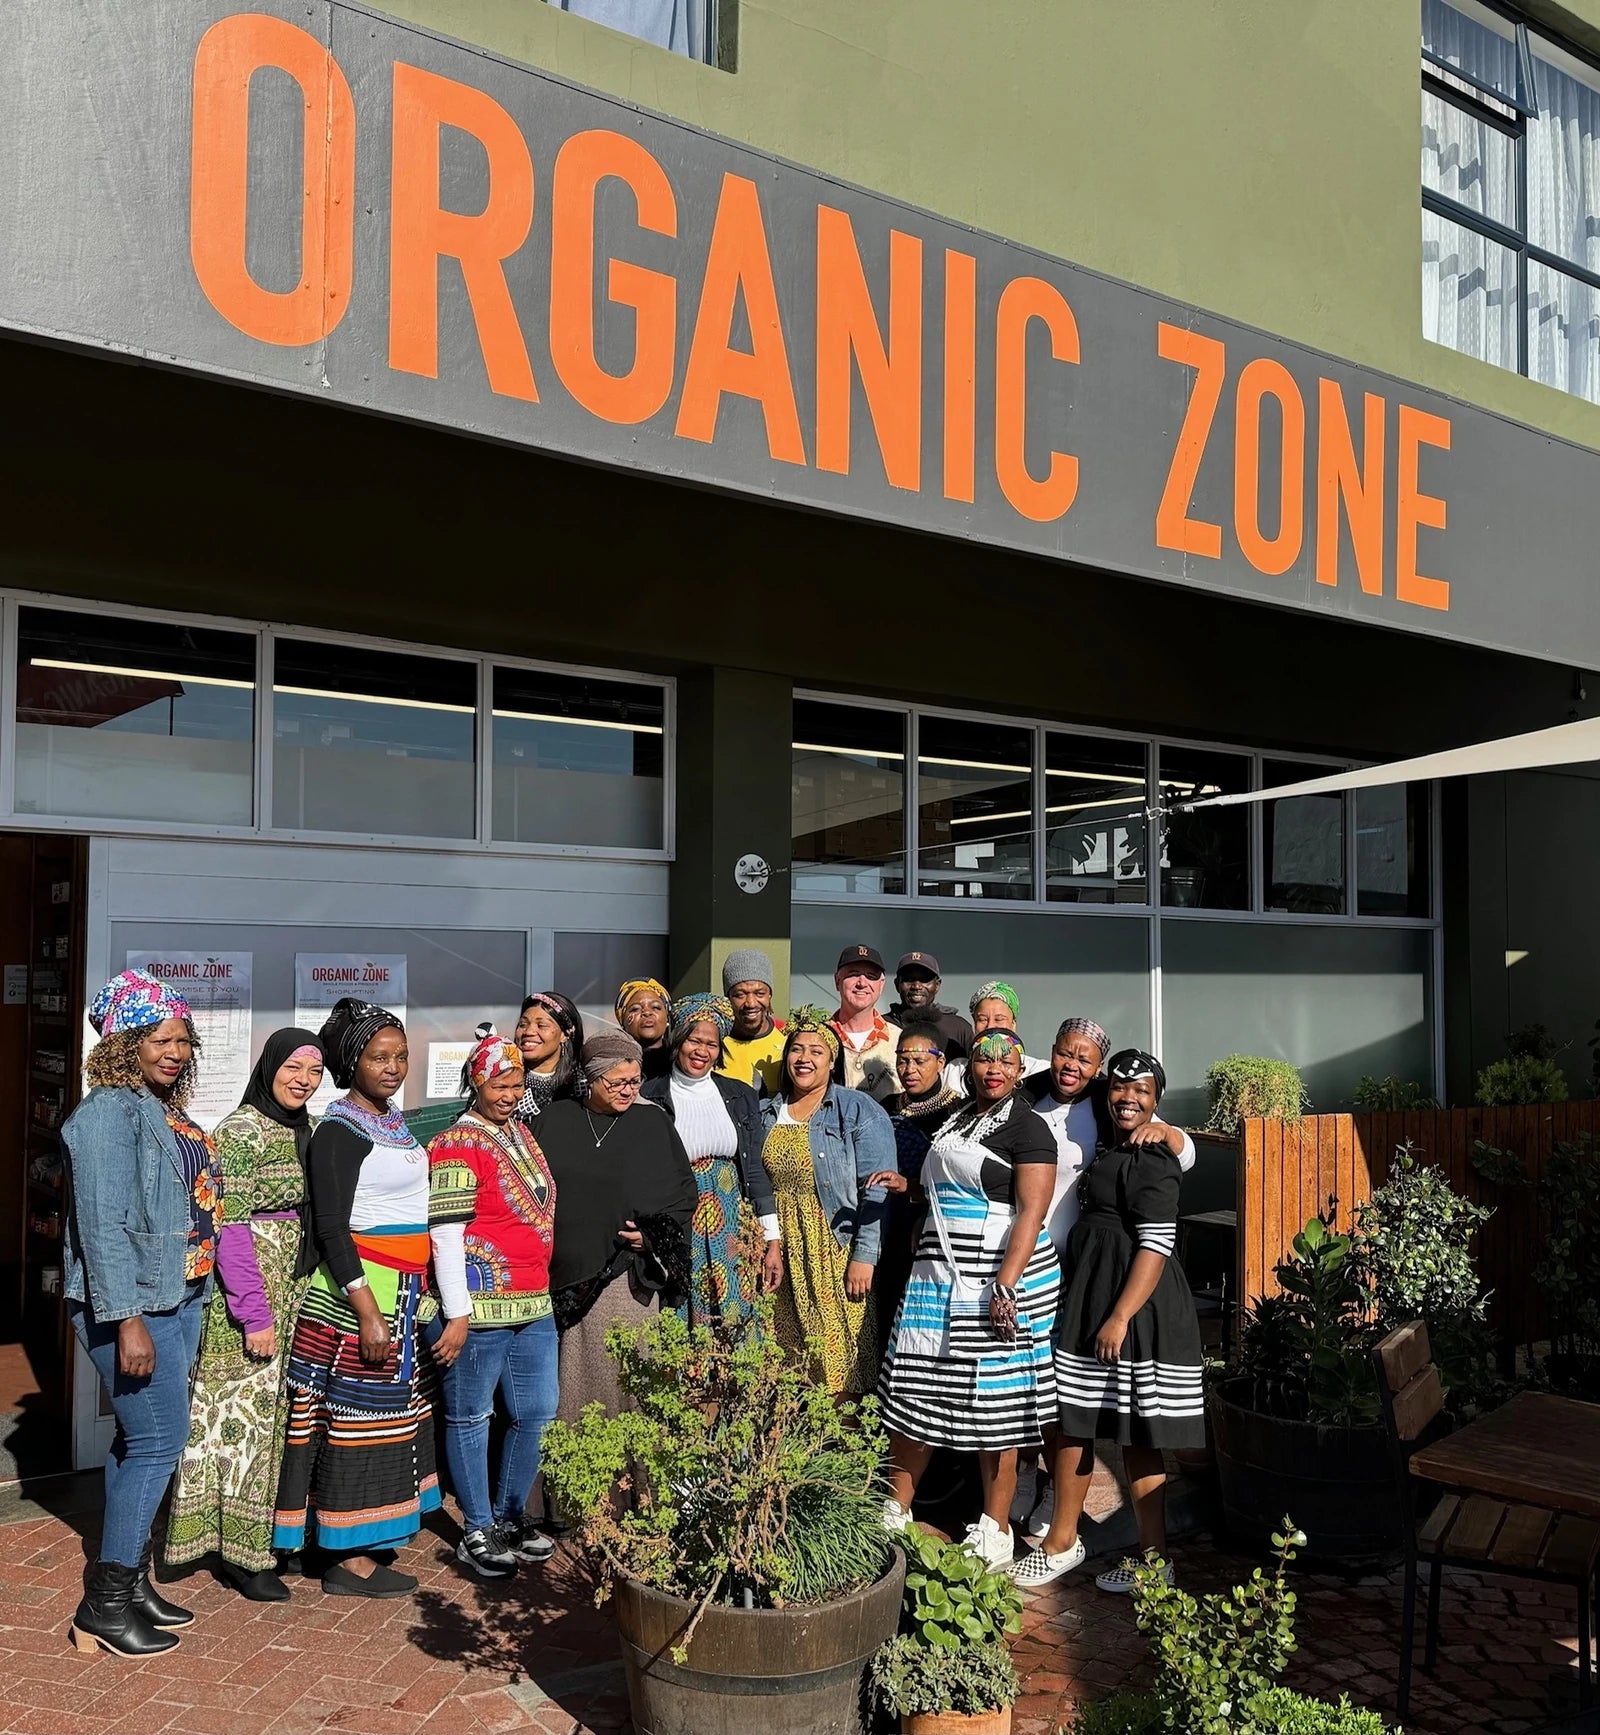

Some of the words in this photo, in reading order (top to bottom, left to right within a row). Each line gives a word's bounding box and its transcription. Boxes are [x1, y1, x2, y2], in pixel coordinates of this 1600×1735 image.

[190, 13, 1080, 522] ORGANIC
[1156, 321, 1451, 611] ZONE
[147, 963, 199, 978] ORGANIC
[202, 963, 233, 978] ZONE
[312, 967, 360, 982] ORGANIC
[362, 968, 390, 982] ZONE
[439, 1051, 470, 1061] ORGANI
